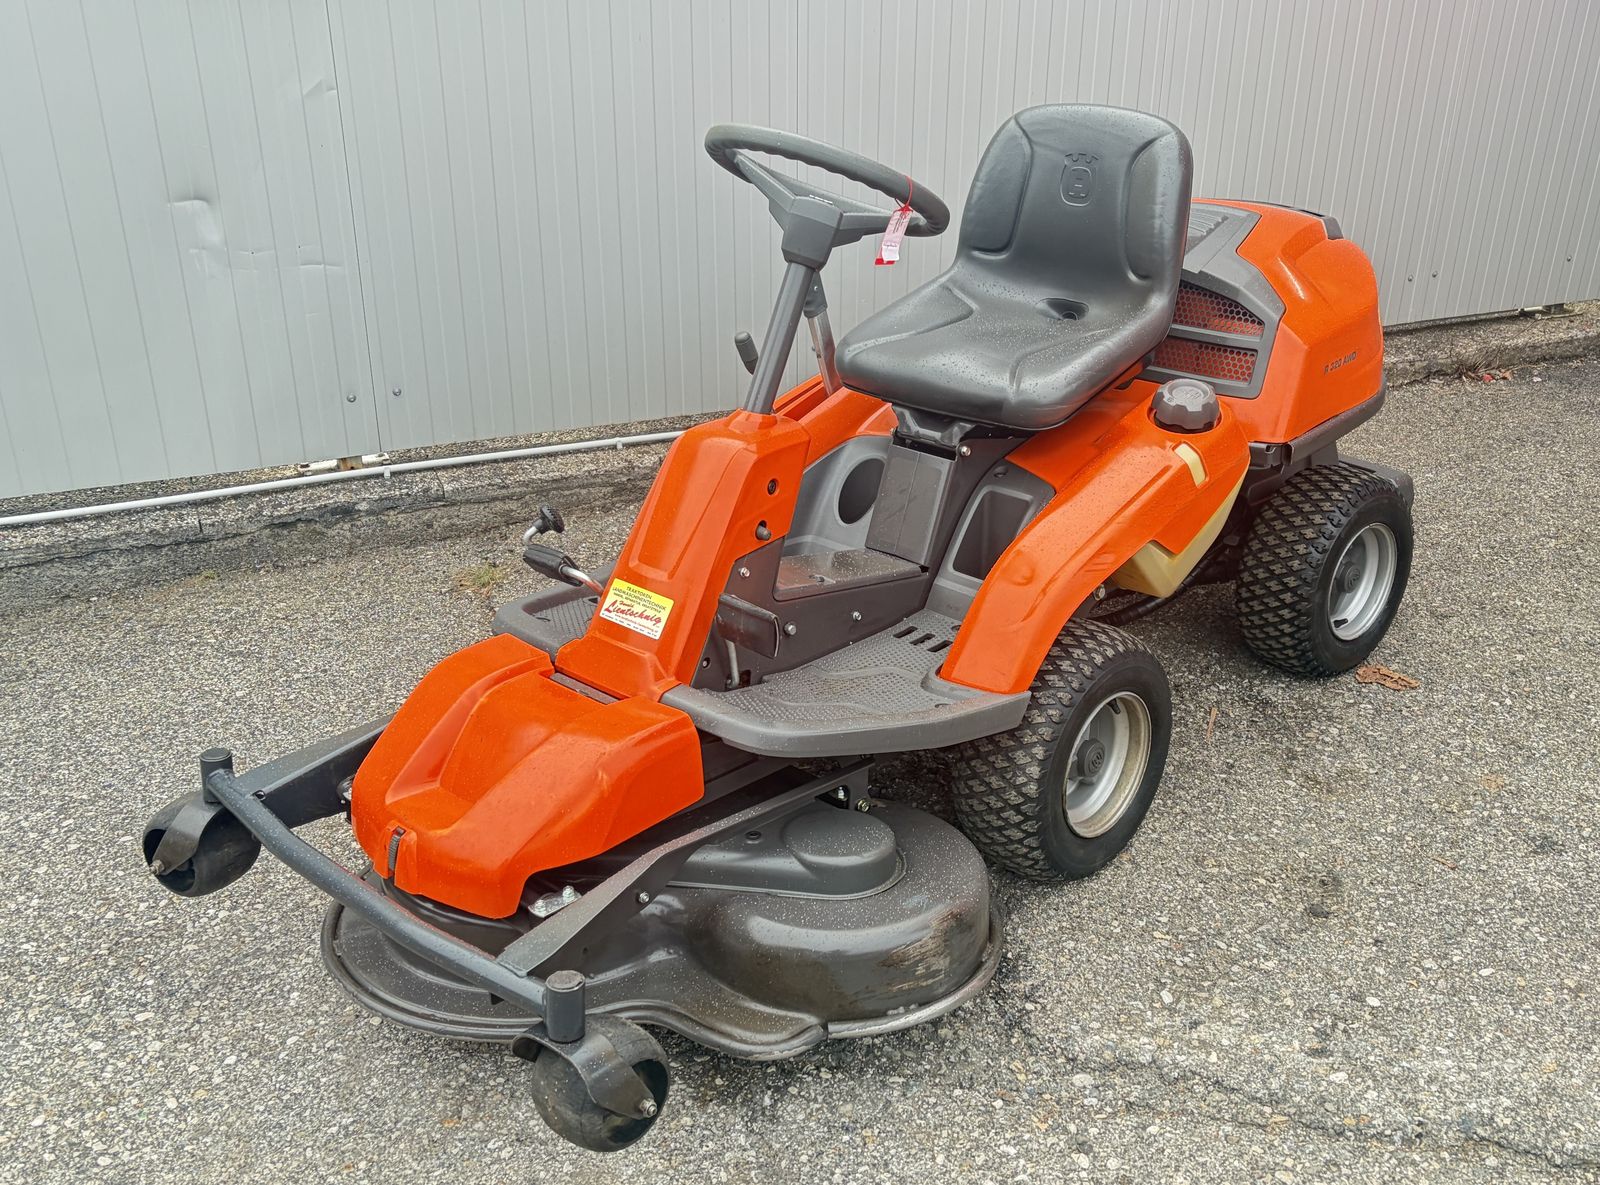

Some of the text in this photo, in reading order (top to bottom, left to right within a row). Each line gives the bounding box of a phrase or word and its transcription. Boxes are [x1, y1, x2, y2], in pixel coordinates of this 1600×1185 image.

[1330, 358, 1342, 371] 320
[1343, 351, 1357, 366] AWD
[626, 586, 653, 600] TRAKTOREN
